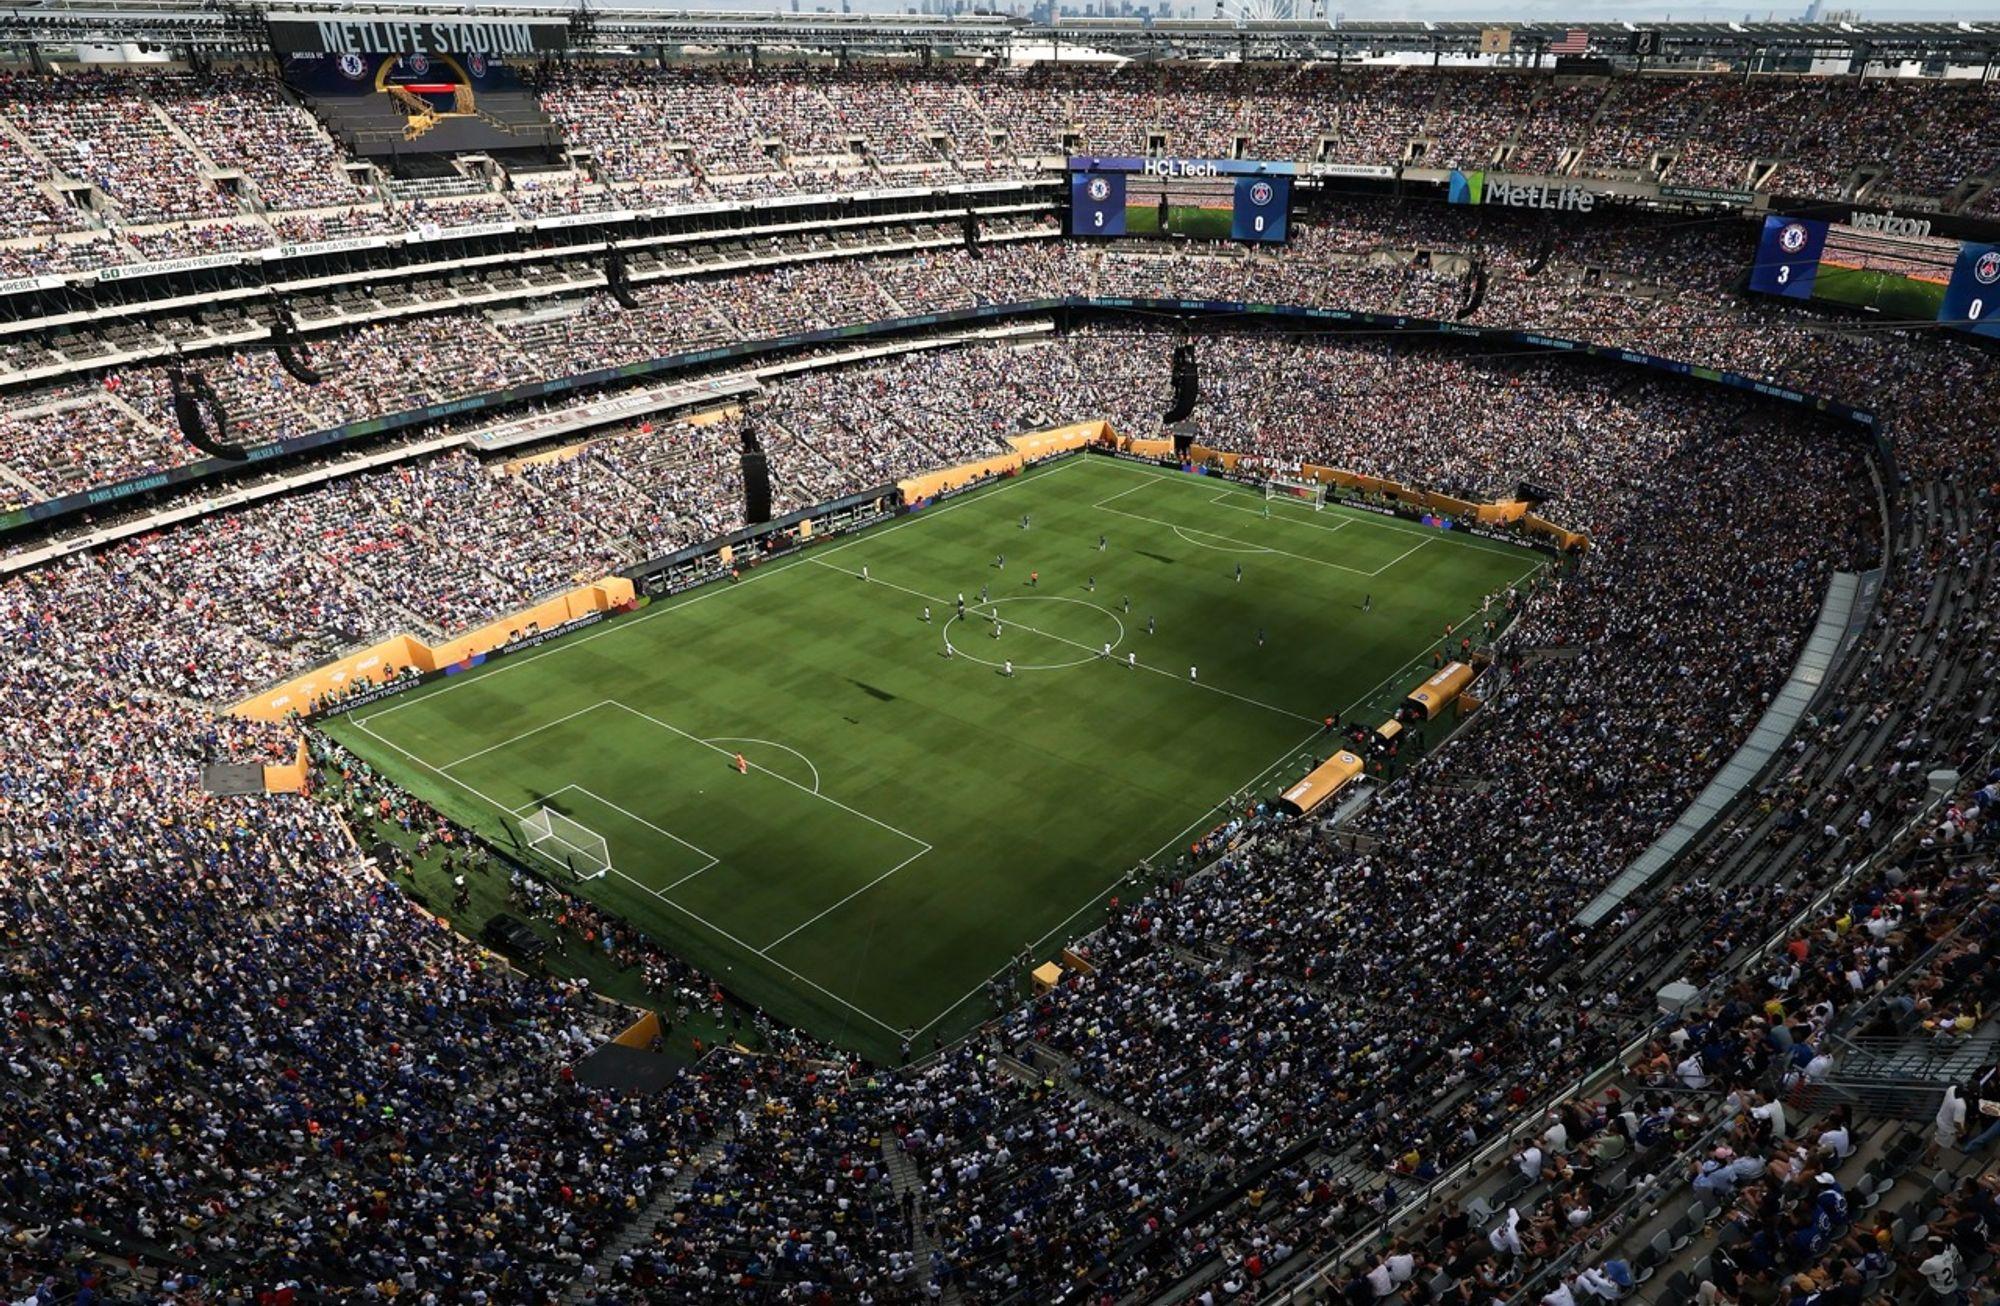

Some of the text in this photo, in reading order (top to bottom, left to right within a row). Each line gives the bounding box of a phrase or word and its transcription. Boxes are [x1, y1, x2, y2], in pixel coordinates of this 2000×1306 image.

[318, 21, 534, 53] METLIFE STADIUM
[1145, 160, 1217, 177] HCLTech
[1486, 180, 1595, 213] MetLife
[1094, 211, 1104, 227] 3
[1254, 216, 1264, 231] 0
[1851, 211, 1931, 237] verizon
[280, 246, 297, 256] 99
[100, 267, 120, 280] 60
[1778, 265, 1791, 284] 3
[1968, 298, 1983, 320] 0
[88, 488, 112, 504] PARIS
[1470, 528, 1490, 537] NEXT
[503, 614, 604, 655] REGISTER YOUR INTEREST
[326, 679, 420, 717] FIFA.COM/TICKETS
